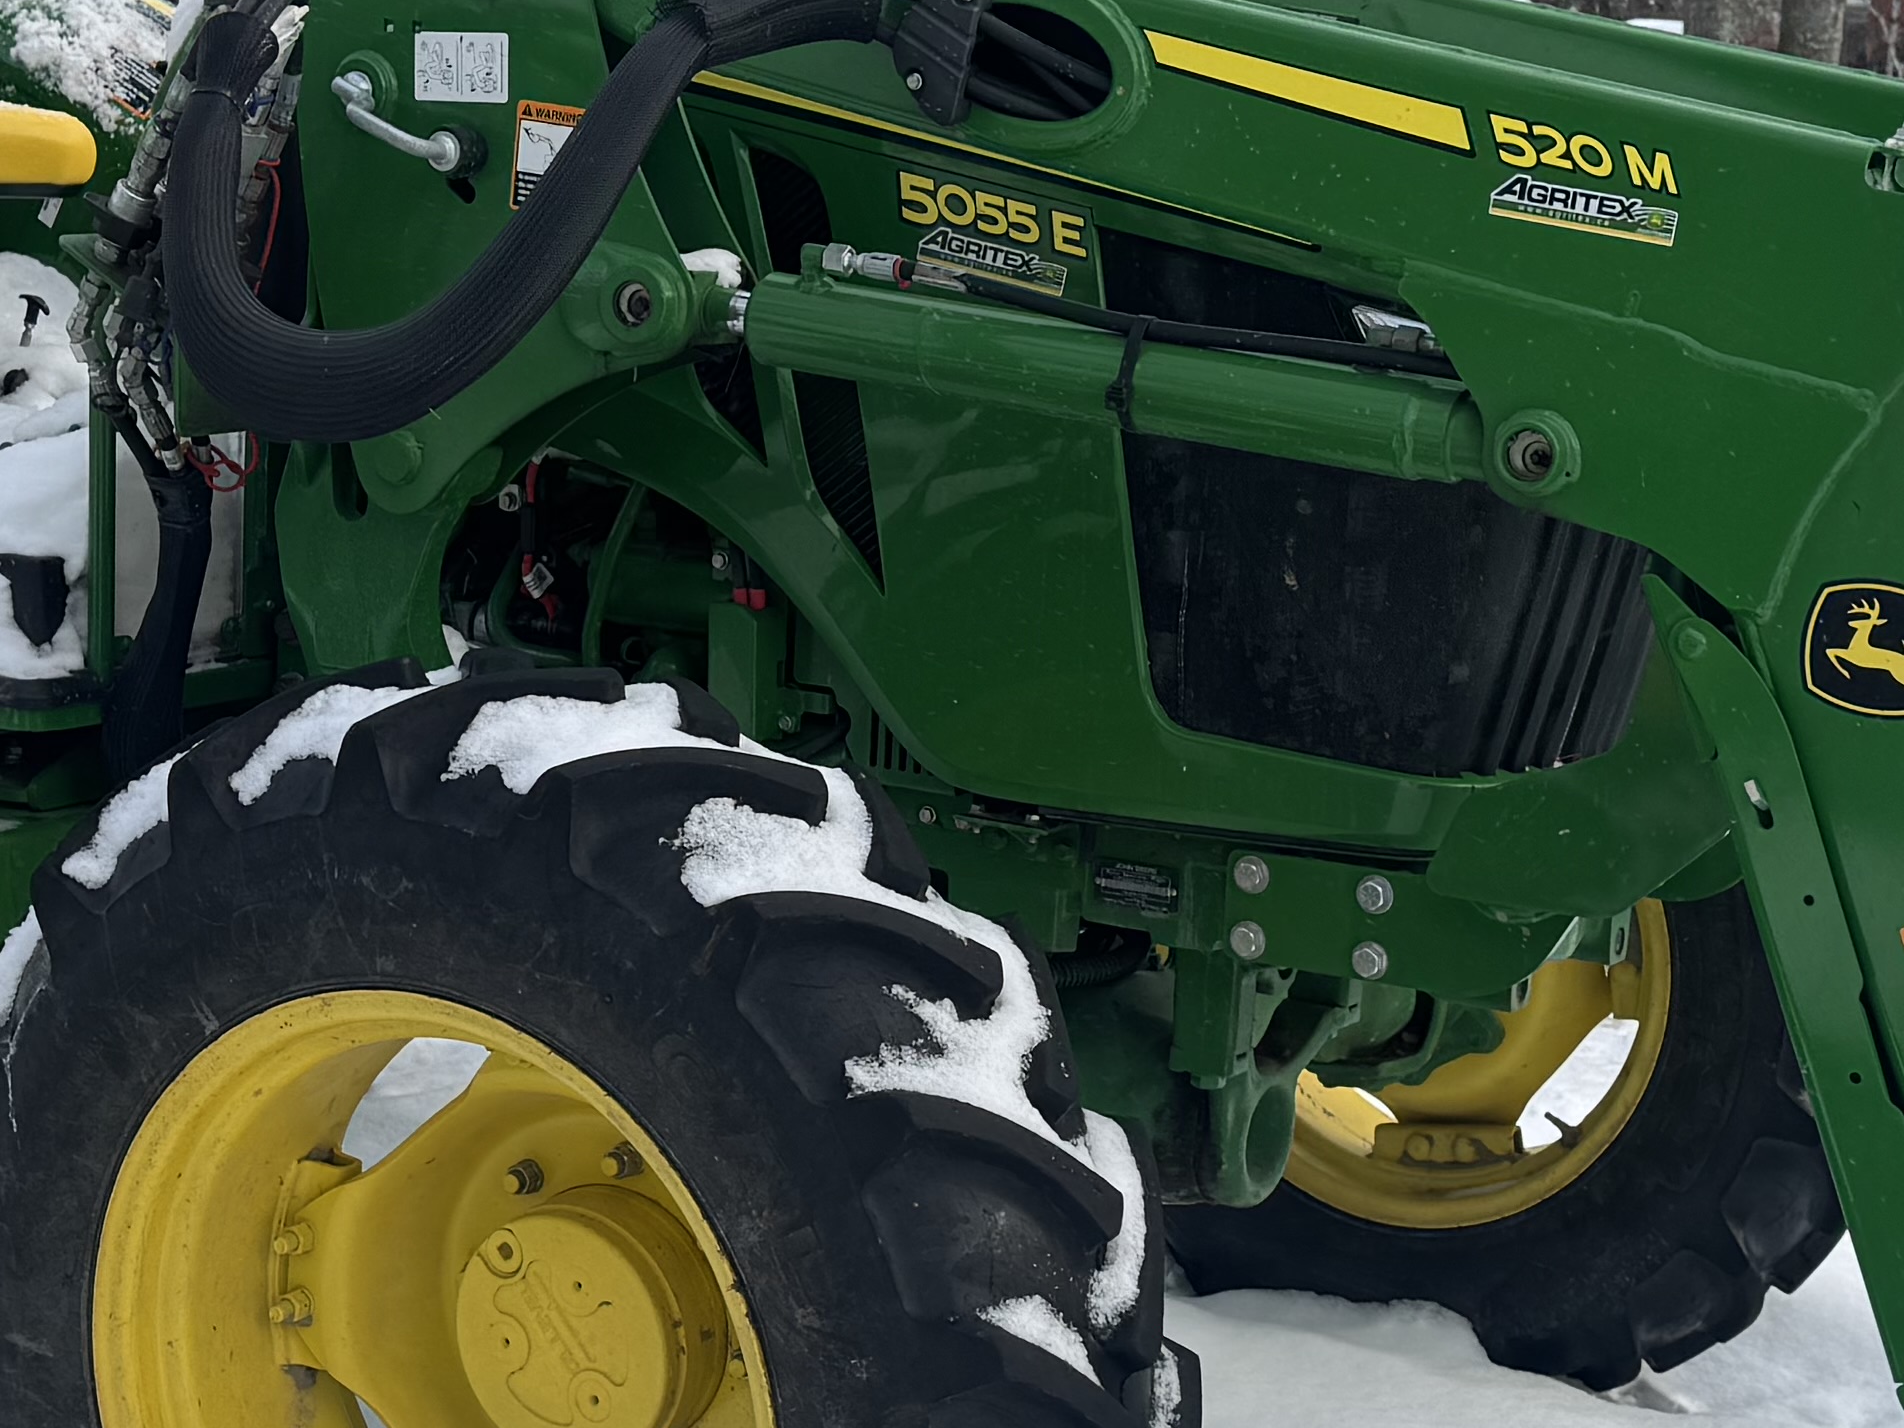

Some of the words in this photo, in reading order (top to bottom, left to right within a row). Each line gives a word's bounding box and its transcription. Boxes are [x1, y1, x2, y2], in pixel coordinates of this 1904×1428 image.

[1488, 112, 1614, 178] 520
[1622, 143, 1679, 196] M
[899, 171, 1041, 244] 5055
[1051, 209, 1088, 258] E
[1495, 175, 1640, 221] AGRITEX
[920, 229, 1038, 273] AGRITEX
